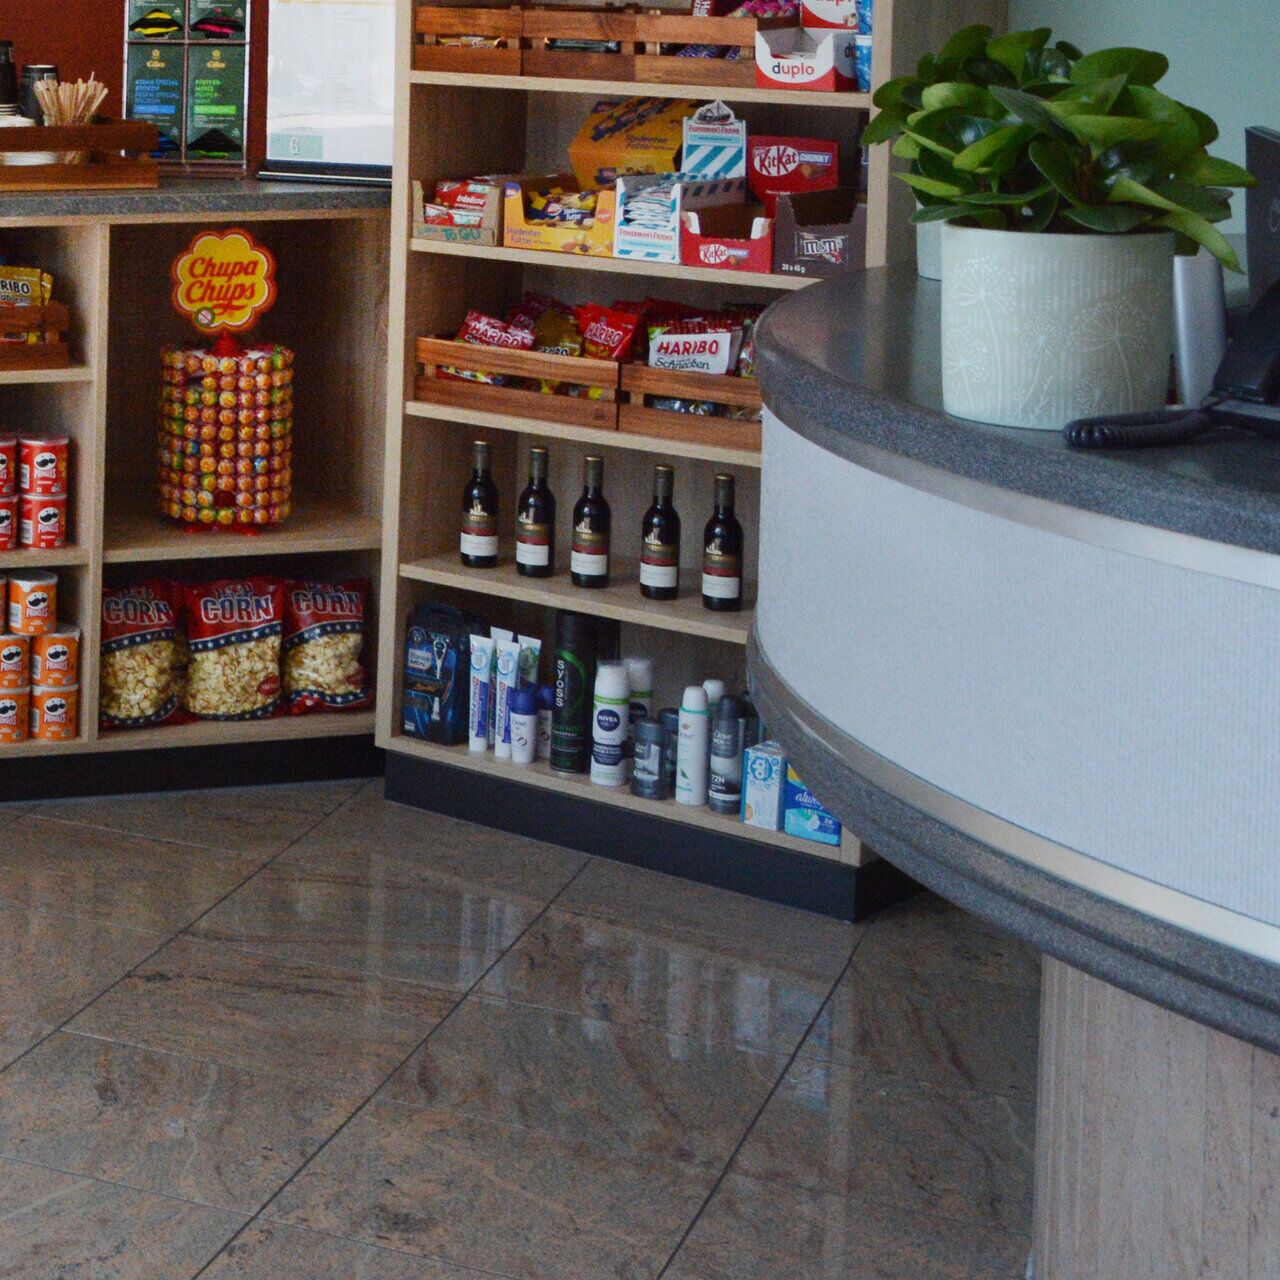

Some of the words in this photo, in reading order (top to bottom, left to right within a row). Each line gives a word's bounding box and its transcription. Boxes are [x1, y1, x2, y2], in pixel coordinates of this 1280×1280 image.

[772, 62, 815, 78] duplo
[759, 146, 797, 175] KitKat
[188, 256, 258, 283] Chupa
[185, 279, 256, 307] Chups
[584, 321, 623, 347] HARIBO
[656, 339, 720, 356] HARIBO
[103, 597, 174, 624] CORN
[200, 594, 274, 623] CORN
[292, 590, 363, 615] CORN
[556, 659, 565, 708] SYOSS
[598, 714, 619, 723] NIVEA
